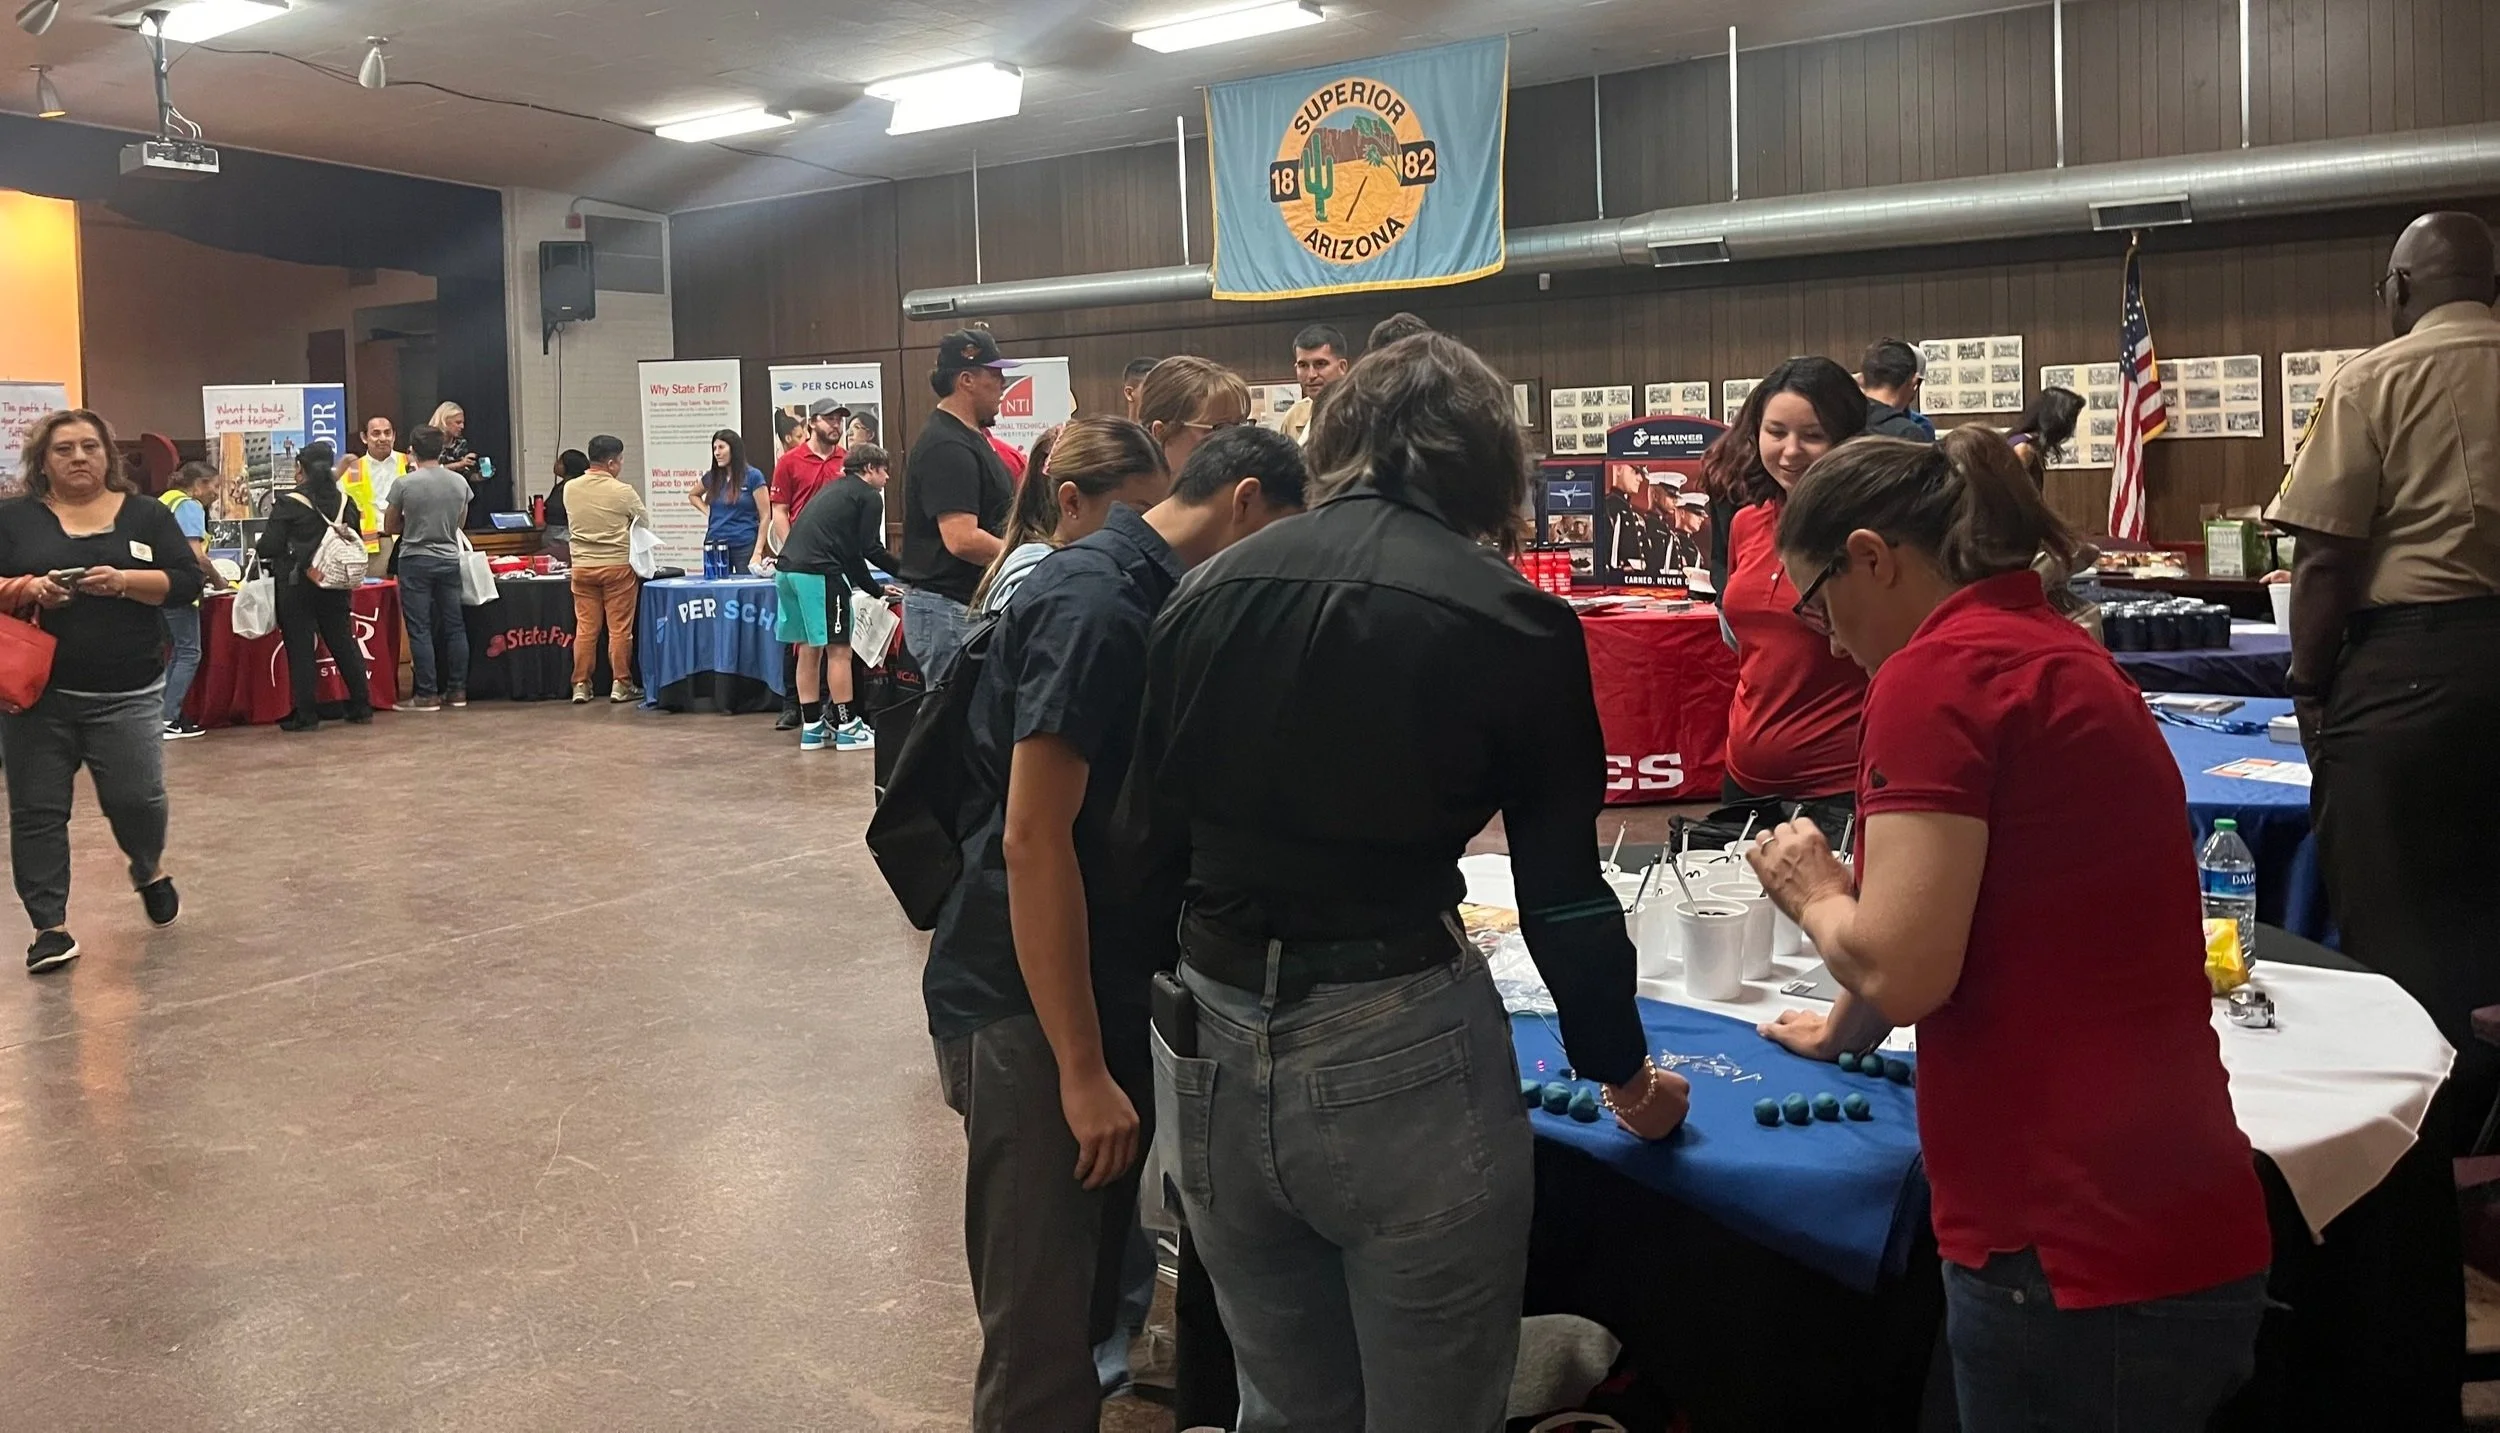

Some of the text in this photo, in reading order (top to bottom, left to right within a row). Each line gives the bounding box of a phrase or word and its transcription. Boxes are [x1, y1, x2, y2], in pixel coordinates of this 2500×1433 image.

[1294, 81, 1406, 135] SUPERIOR
[1271, 148, 1435, 195] 18 82
[1304, 216, 1406, 260] ARIZONA
[650, 384, 669, 396] Why
[672, 383, 695, 394] State
[802, 380, 874, 390] PER SCHOLAS
[216, 403, 285, 414] Want to build
[1006, 398, 1030, 413] NTI
[215, 413, 285, 429] great things?
[1650, 433, 1703, 442] MARINES
[652, 468, 671, 477] What
[673, 469, 697, 477] makes
[652, 480, 671, 489] place
[674, 479, 681, 487] to
[1624, 575, 1655, 585] EARNED.
[1656, 576, 1683, 586] NEVER
[678, 598, 717, 623] PER
[506, 625, 574, 649] State Far
